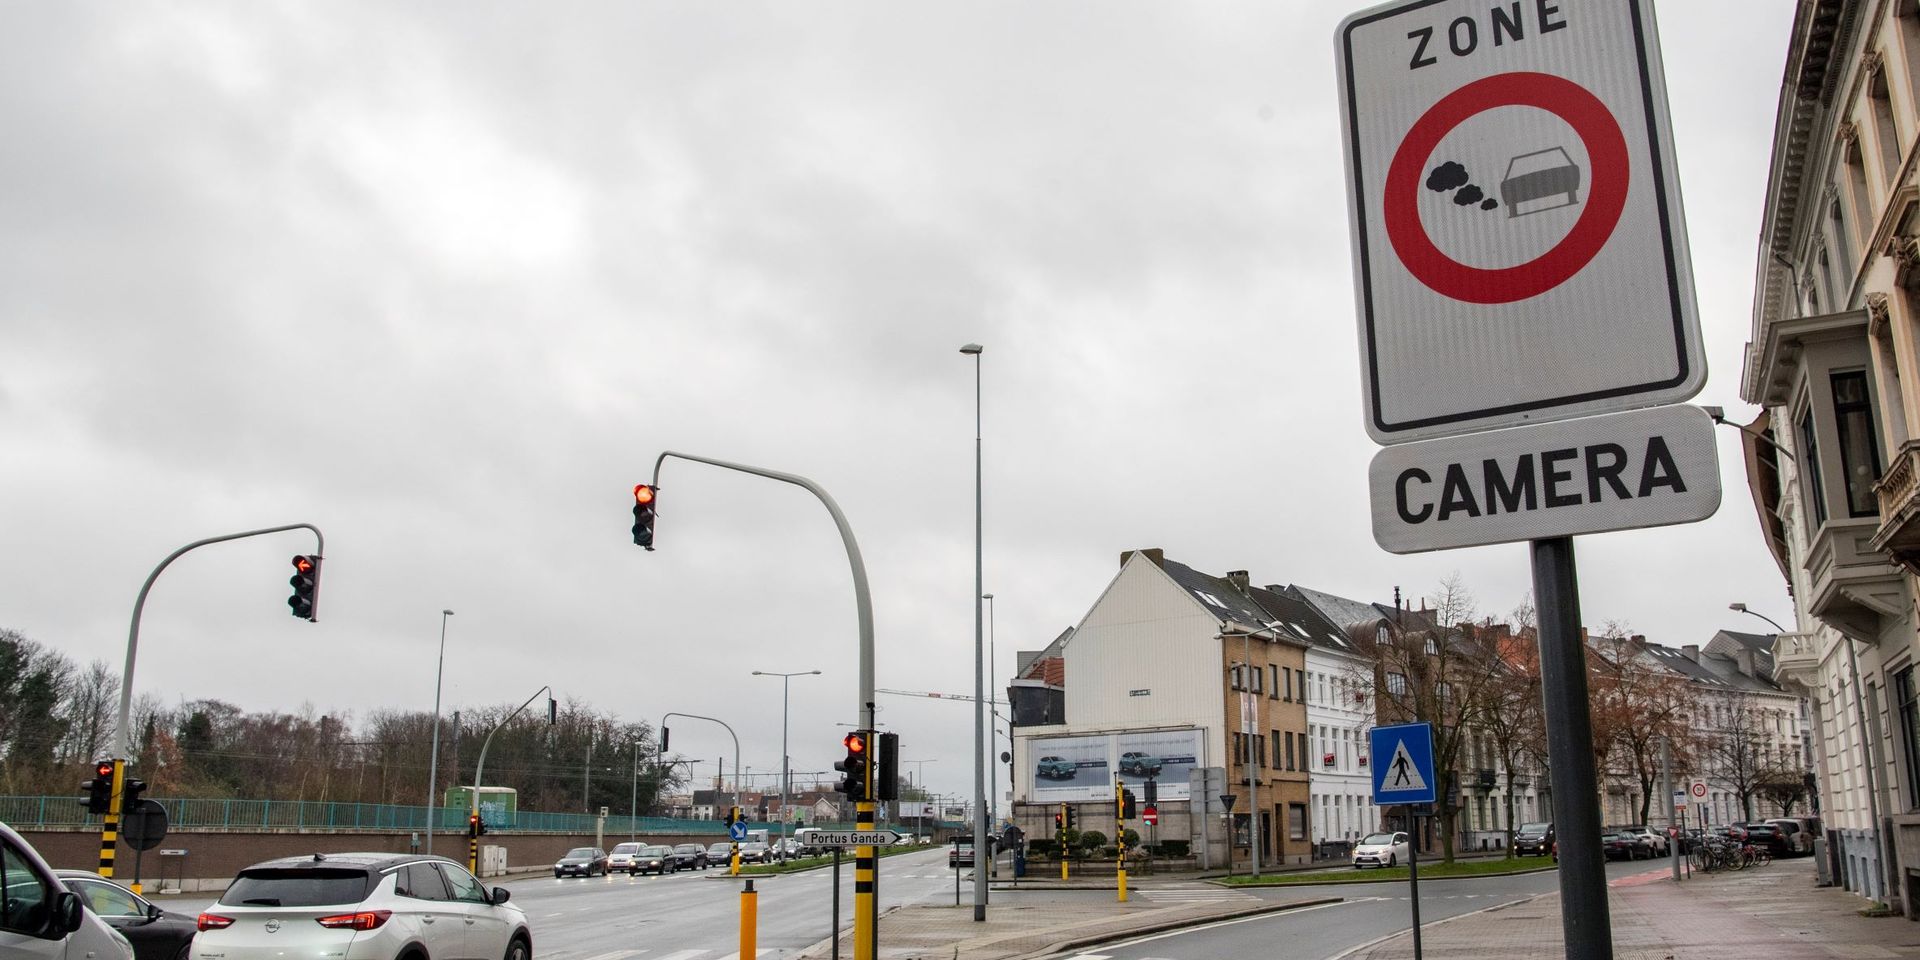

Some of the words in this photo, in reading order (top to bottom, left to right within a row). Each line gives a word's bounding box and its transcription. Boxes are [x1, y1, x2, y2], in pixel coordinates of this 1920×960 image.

[1407, 0, 1567, 70] ZONE
[1395, 436, 1688, 525] CAMERA
[811, 833, 847, 844] Portus
[851, 833, 885, 844] Ganda
